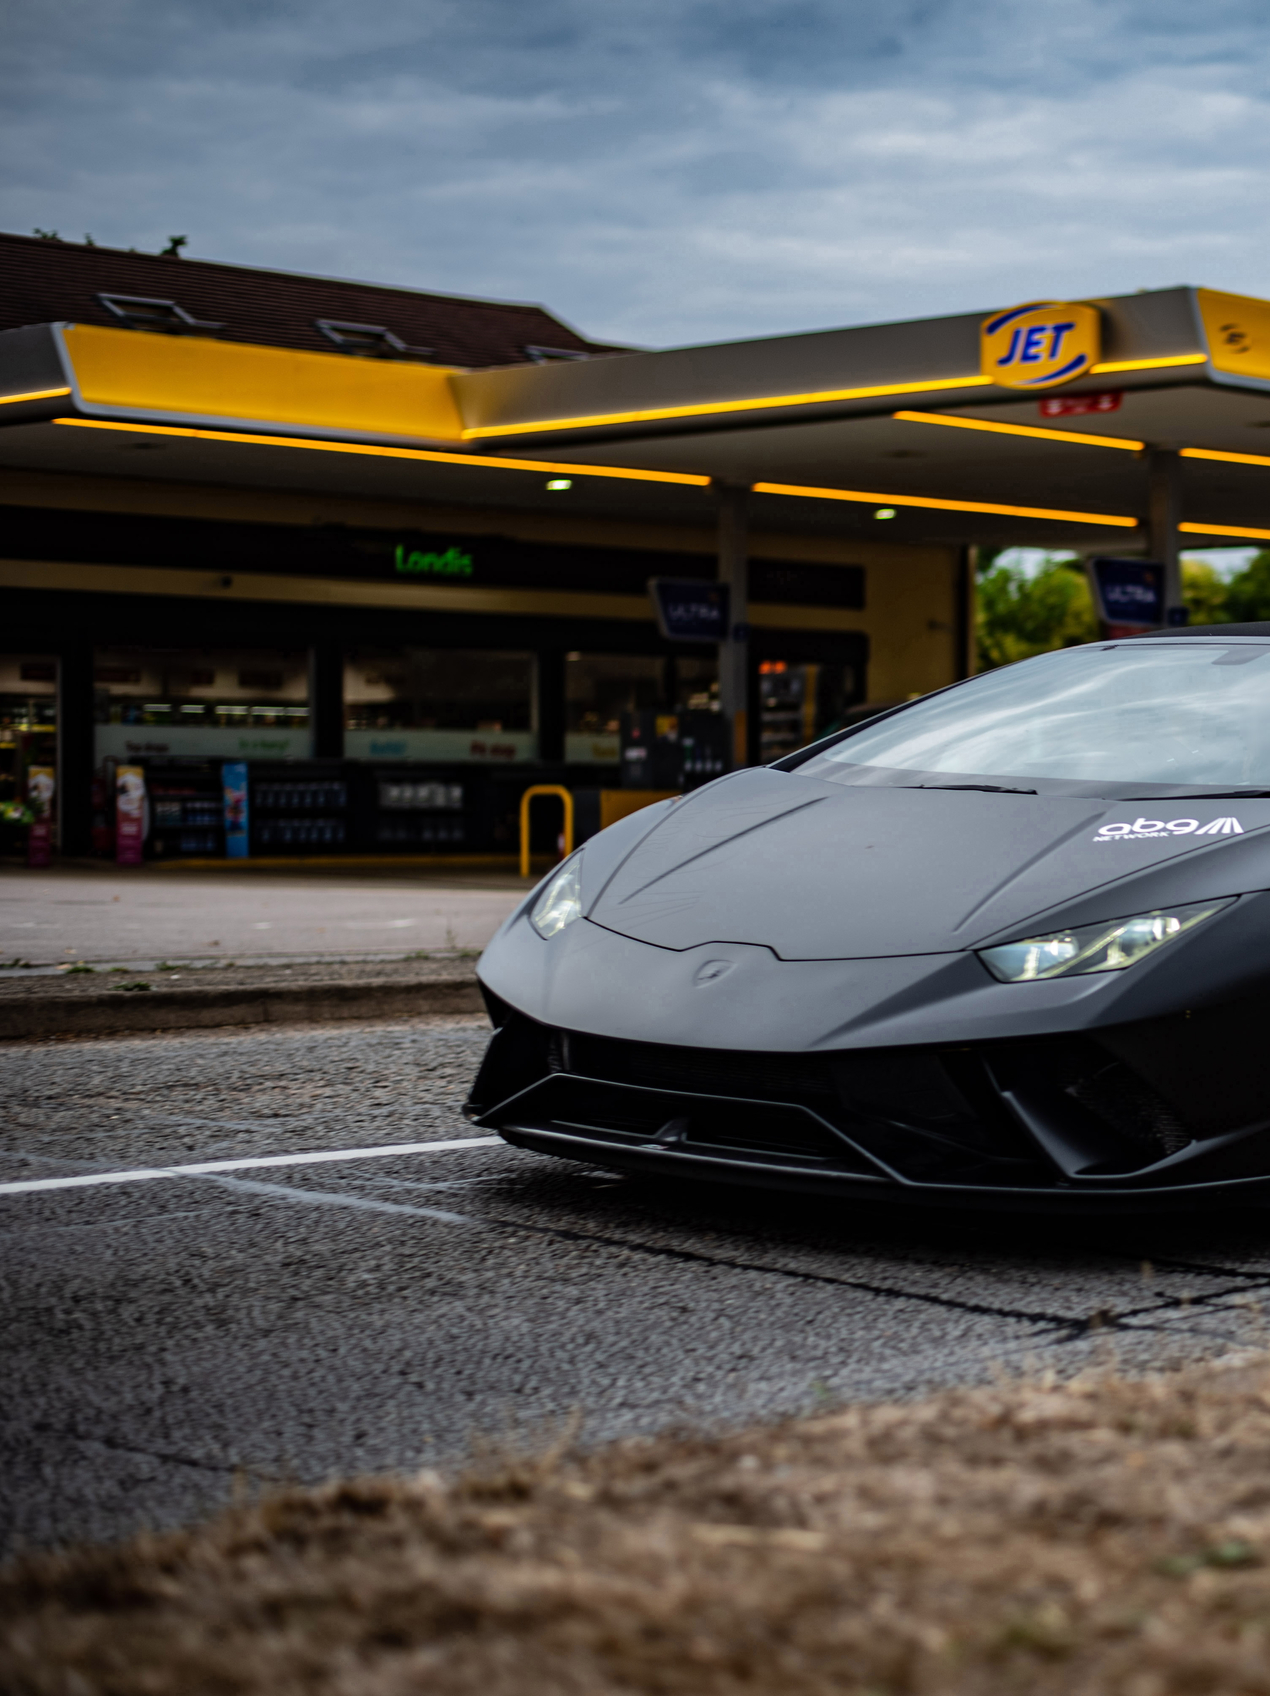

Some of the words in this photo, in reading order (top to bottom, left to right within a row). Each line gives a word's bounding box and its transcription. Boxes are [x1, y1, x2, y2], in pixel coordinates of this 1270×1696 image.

[997, 322, 1076, 366] JET
[394, 543, 475, 578] Londis
[1092, 831, 1170, 842] NETWORK
